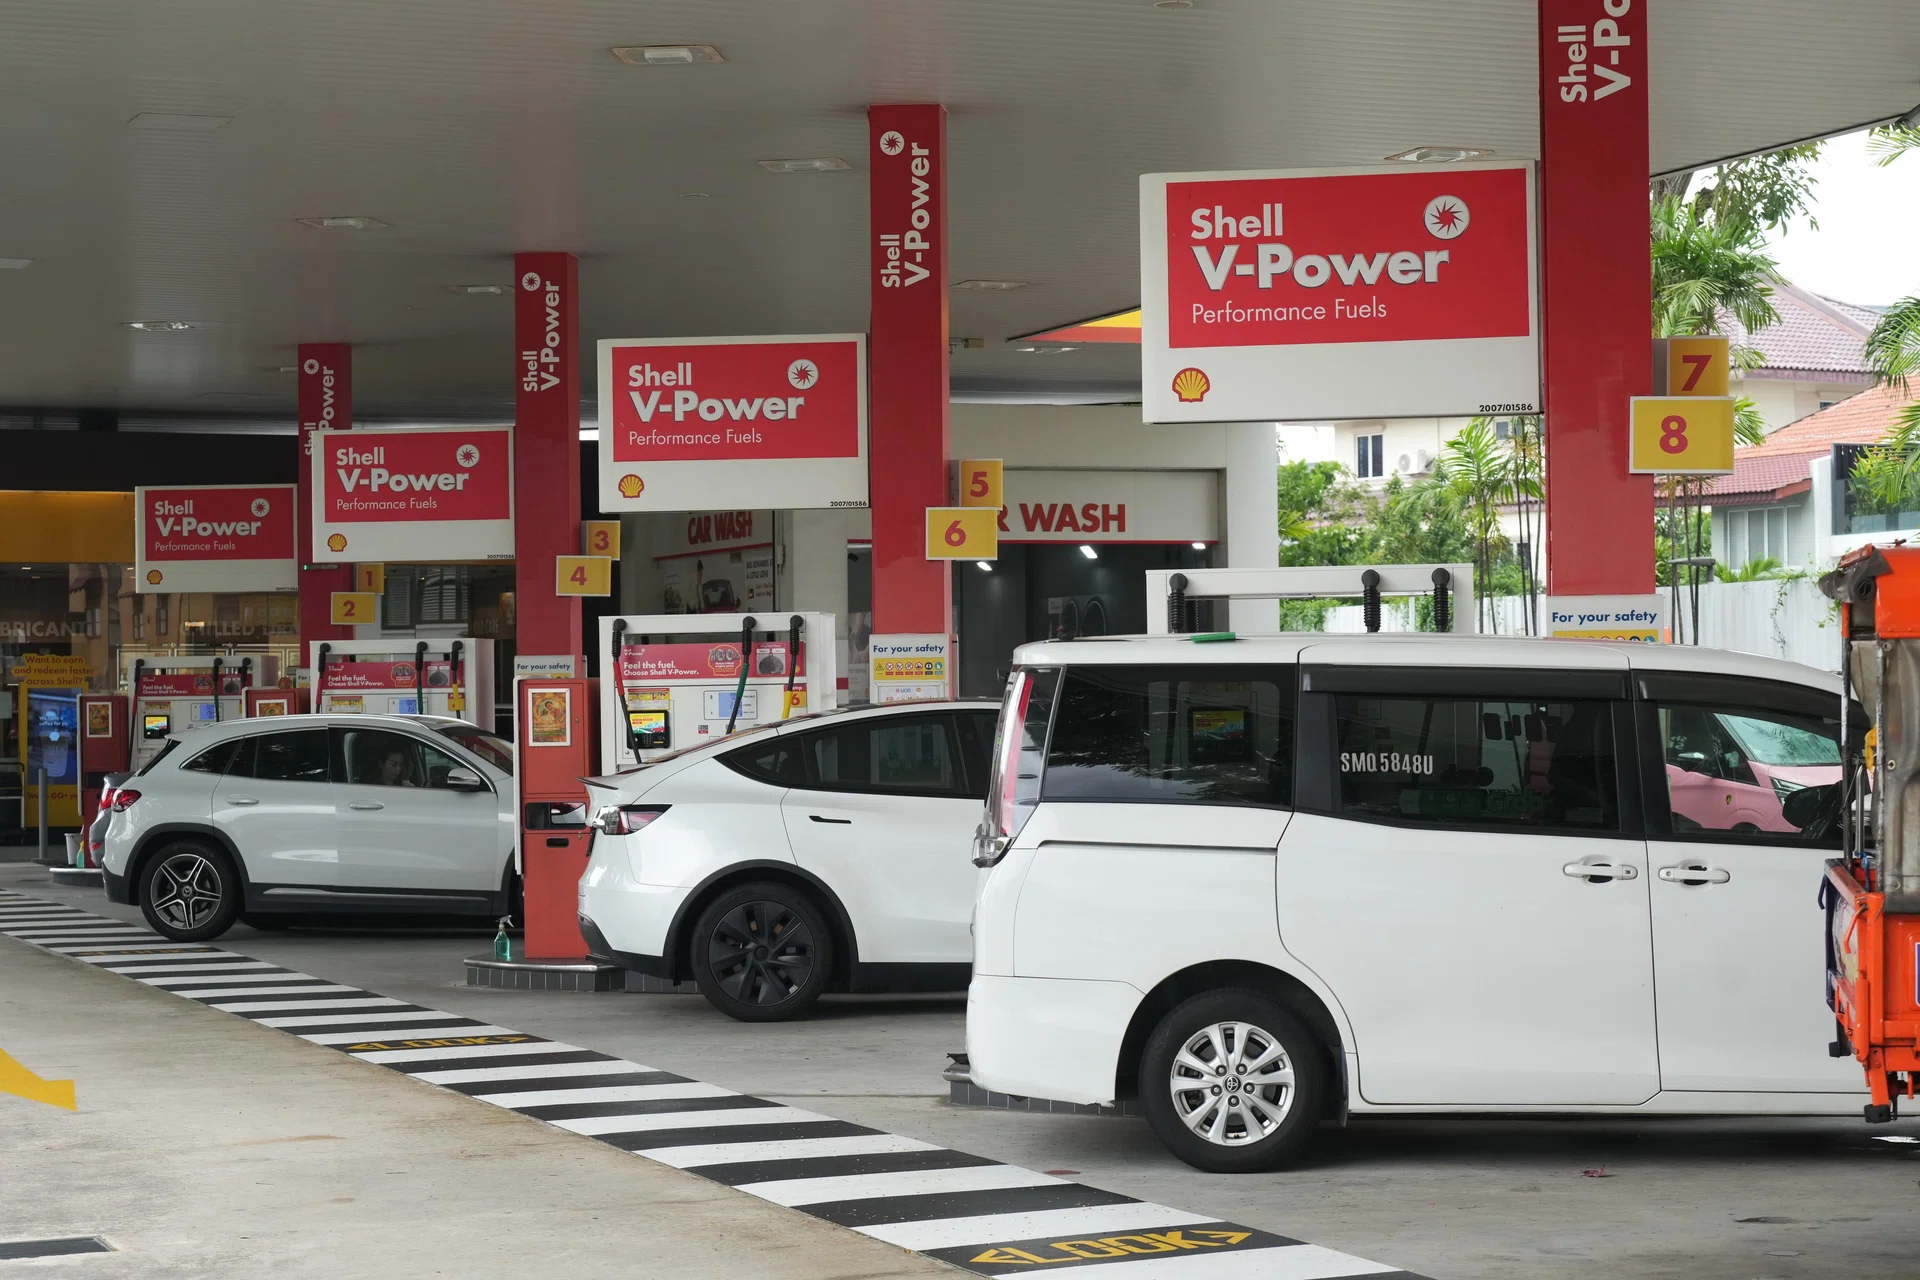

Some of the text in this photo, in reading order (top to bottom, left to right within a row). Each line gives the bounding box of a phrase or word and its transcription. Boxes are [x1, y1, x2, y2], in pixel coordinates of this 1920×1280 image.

[1558, 25, 1588, 103] Shell
[904, 142, 930, 287] V-Power
[1190, 202, 1283, 239] Shell
[880, 234, 900, 288] Shell
[1190, 243, 1450, 291] V-Power
[1192, 296, 1387, 324] Performance Fuels
[540, 280, 560, 392] V-Power
[522, 350, 538, 392] Shell
[628, 362, 692, 387] Shell
[1681, 355, 1712, 392] 7
[628, 390, 805, 422] V-Power
[1479, 403, 1533, 412] 2007/01586
[629, 428, 762, 445] Performance Fuels
[1659, 415, 1688, 455] 8
[336, 446, 385, 466] Shell
[336, 468, 469, 493] V-Power
[970, 471, 989, 498] 5
[154, 499, 193, 515] Shell
[336, 496, 437, 511] Performance Fuels
[155, 517, 261, 537] V-Power
[688, 511, 753, 545] CAR WASH
[1019, 503, 1126, 533] WASH
[594, 530, 609, 551] 3
[944, 520, 967, 547] 6
[155, 540, 236, 551] Performance Fuels
[365, 571, 373, 586] 1
[570, 566, 587, 586] 4
[343, 600, 356, 617] 2
[1552, 610, 1657, 625] For your safety
[25, 656, 49, 664] Want
[873, 644, 944, 654] For your safety
[14, 666, 94, 675] and redeem faster
[530, 664, 547, 672] your
[549, 663, 571, 671] safety
[658, 661, 676, 669] fuel.
[57, 677, 83, 685] Shell?
[792, 694, 801, 705] 6
[1340, 752, 1433, 775] SMQ 5848U
[1487, 786, 1544, 812] Grab
[375, 1036, 501, 1050] LOOK
[1000, 1230, 1227, 1264] LOOK
